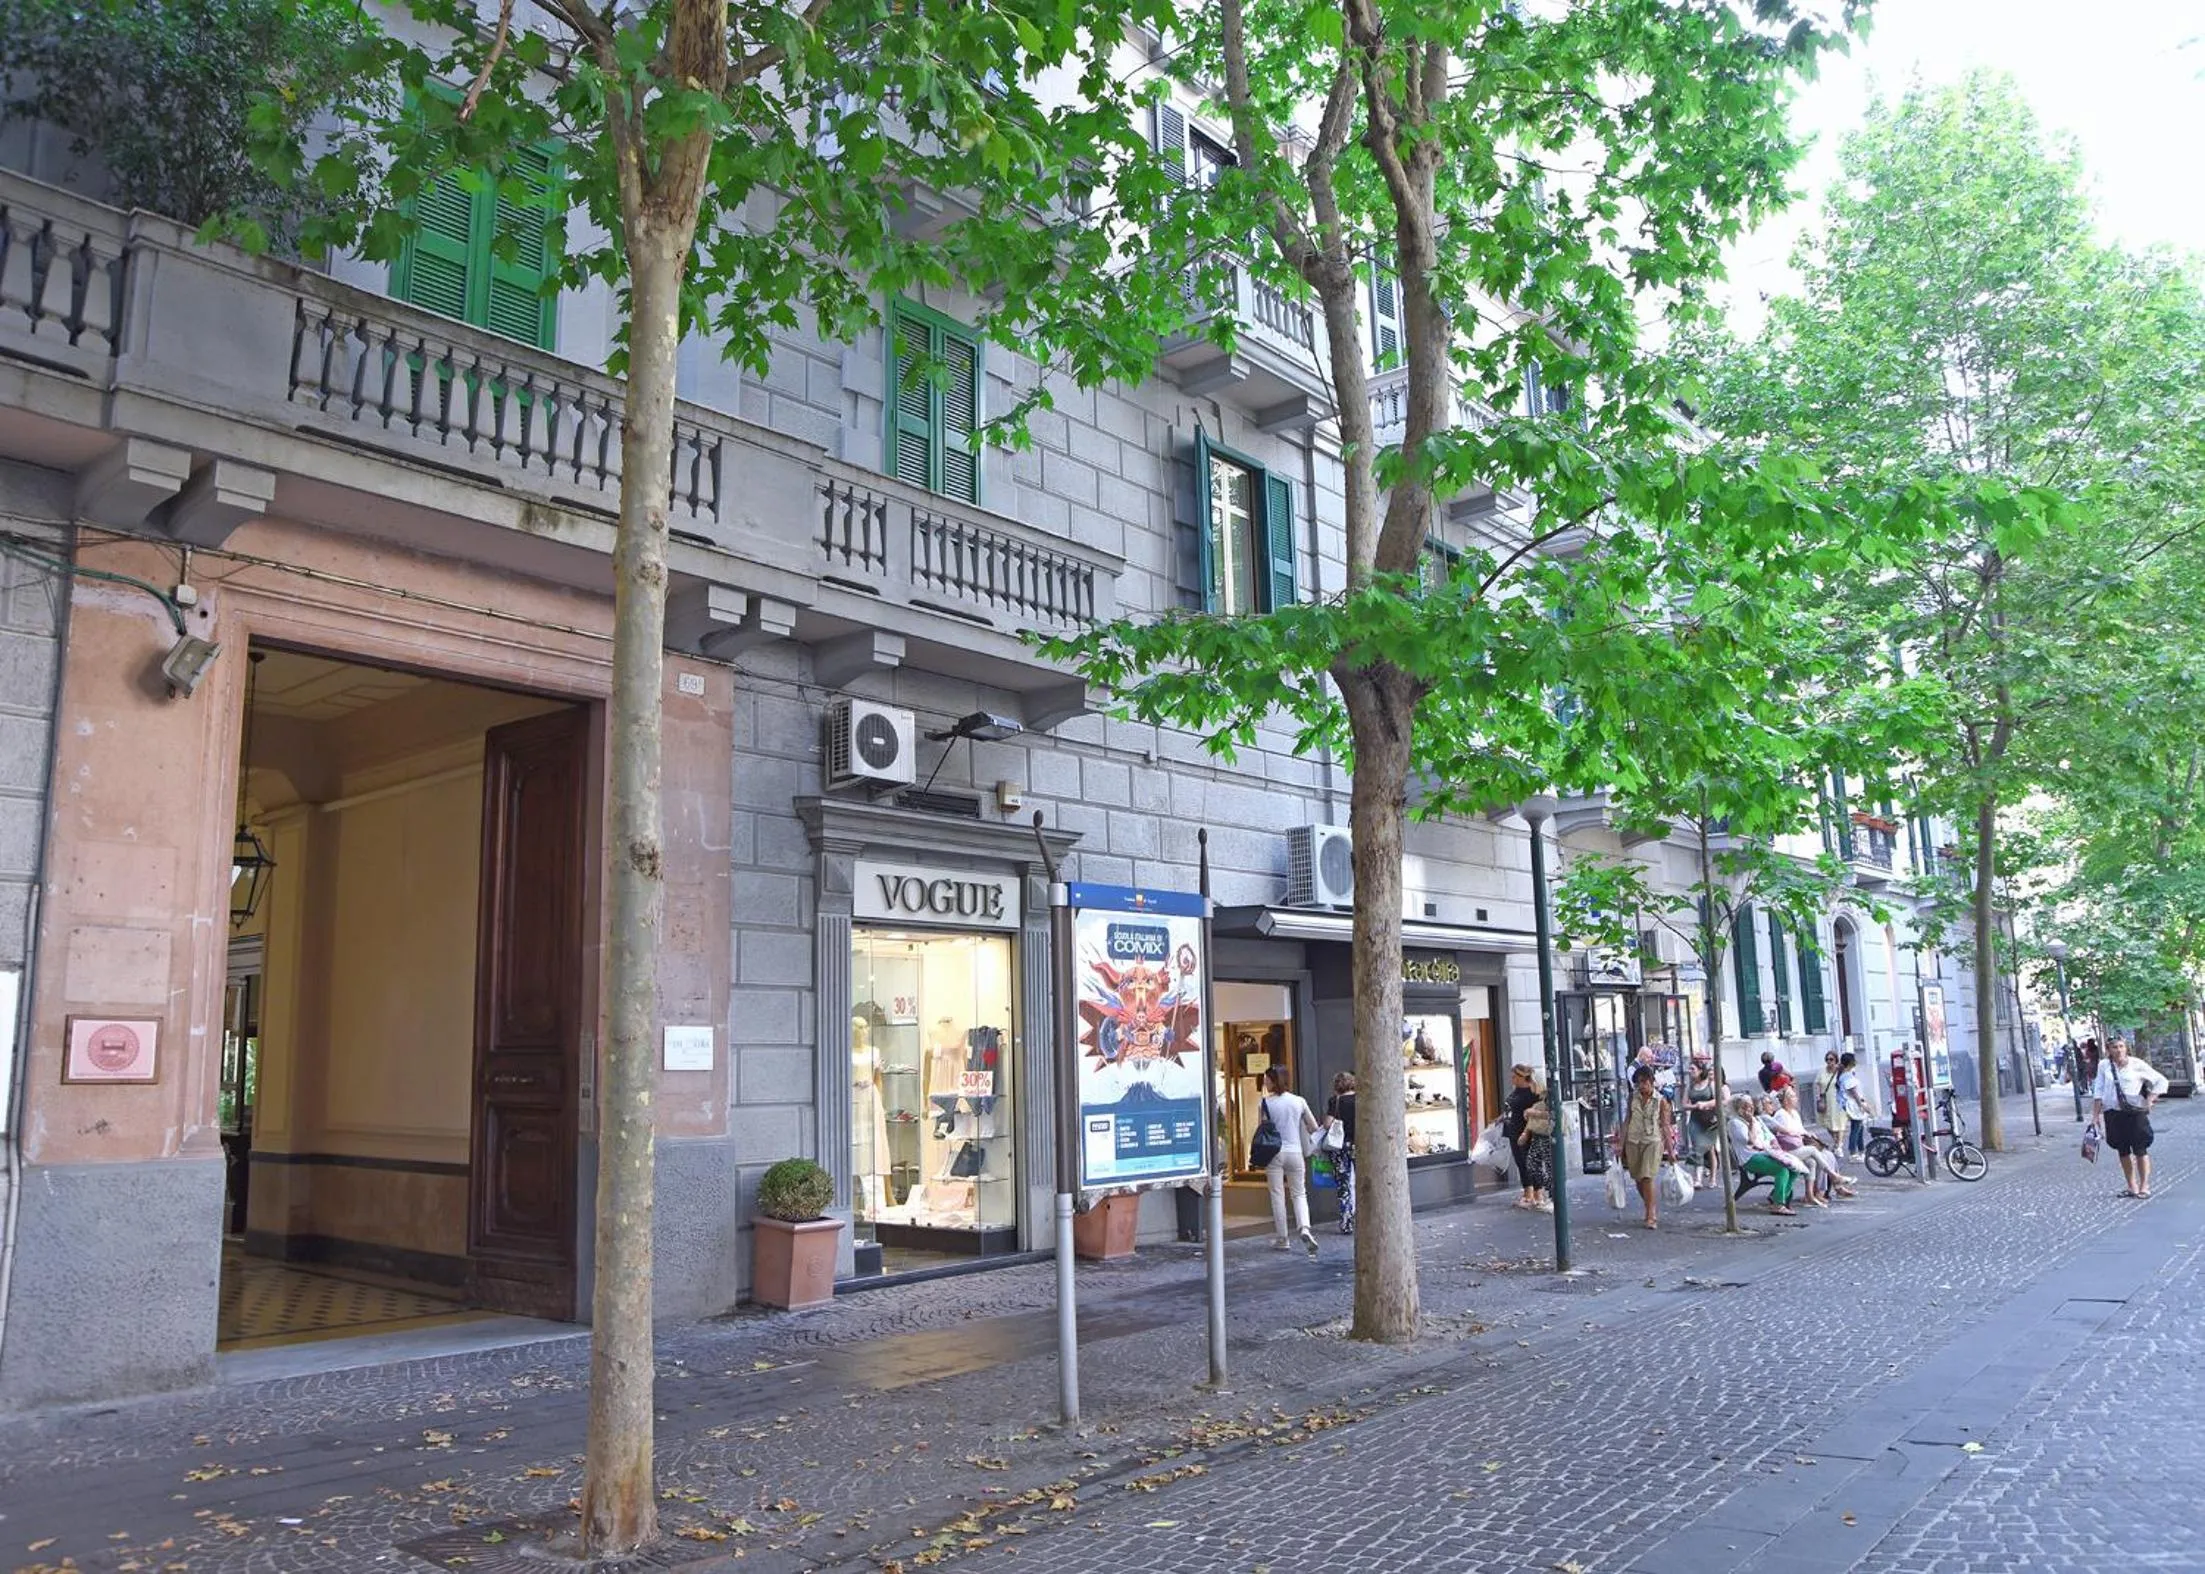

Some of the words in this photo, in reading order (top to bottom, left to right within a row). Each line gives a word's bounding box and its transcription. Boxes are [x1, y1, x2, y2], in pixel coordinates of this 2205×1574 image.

[876, 873, 1005, 920] VOGUE
[1113, 940, 1163, 954] COMIX
[961, 1071, 991, 1088] 30%
